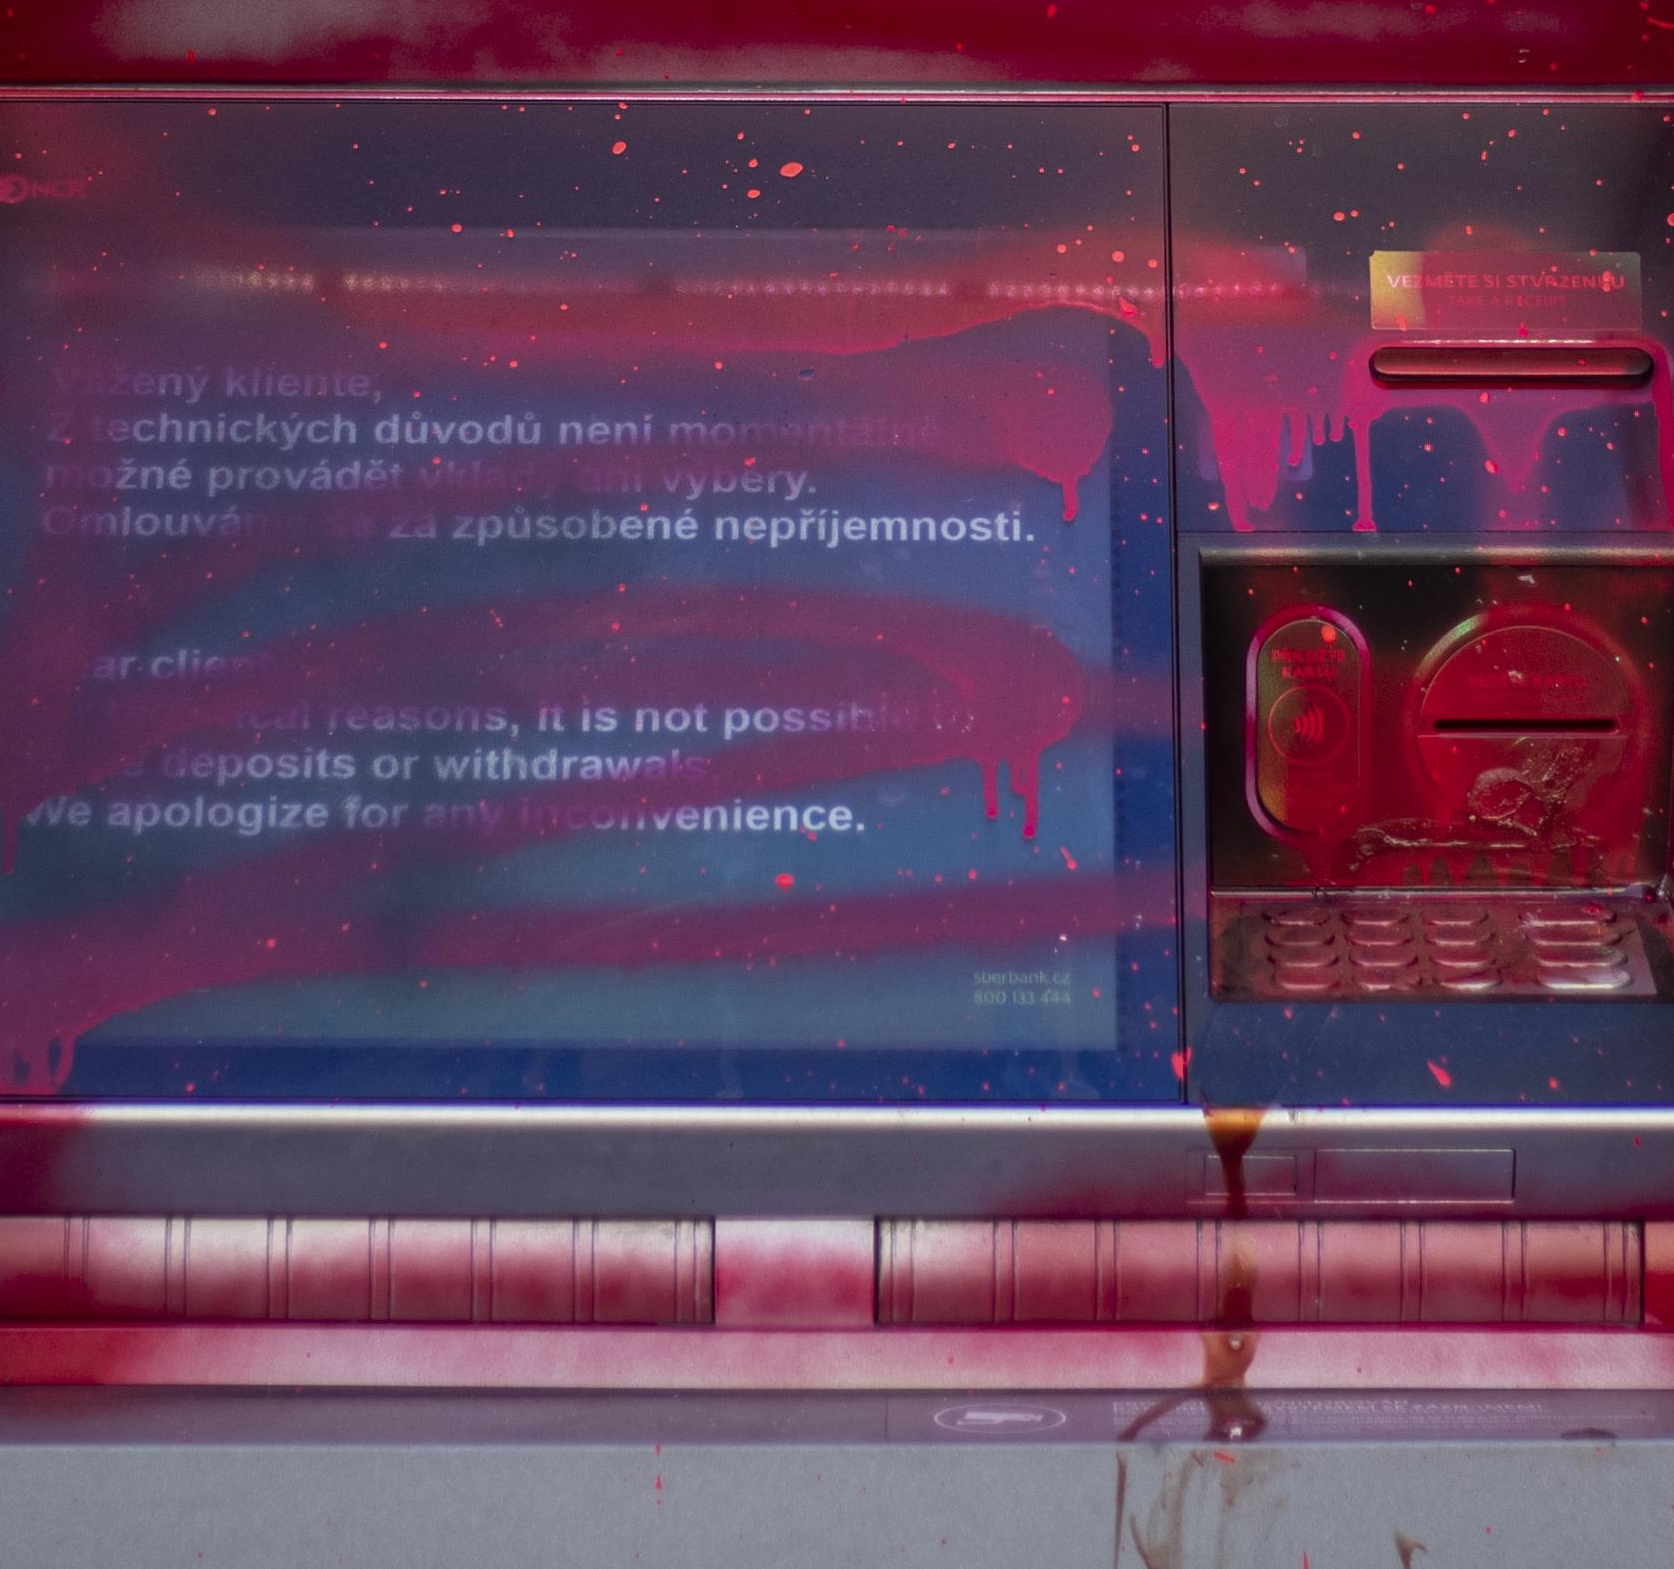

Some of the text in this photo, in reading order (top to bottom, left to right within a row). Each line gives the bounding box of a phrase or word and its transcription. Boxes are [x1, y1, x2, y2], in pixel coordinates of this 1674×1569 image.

[91, 411, 358, 451] technických
[373, 411, 541, 446] důvodů
[558, 413, 654, 446] není
[207, 458, 404, 498] provádět
[451, 505, 699, 547] způsobené
[715, 507, 1035, 549] nepříjemnosti.
[327, 704, 520, 737] reasons,
[538, 701, 565, 732] it
[581, 699, 619, 732] is
[633, 702, 709, 732] not
[161, 746, 357, 785] deposits
[371, 752, 419, 780] or
[106, 794, 331, 836] apologize
[343, 794, 408, 828] for
